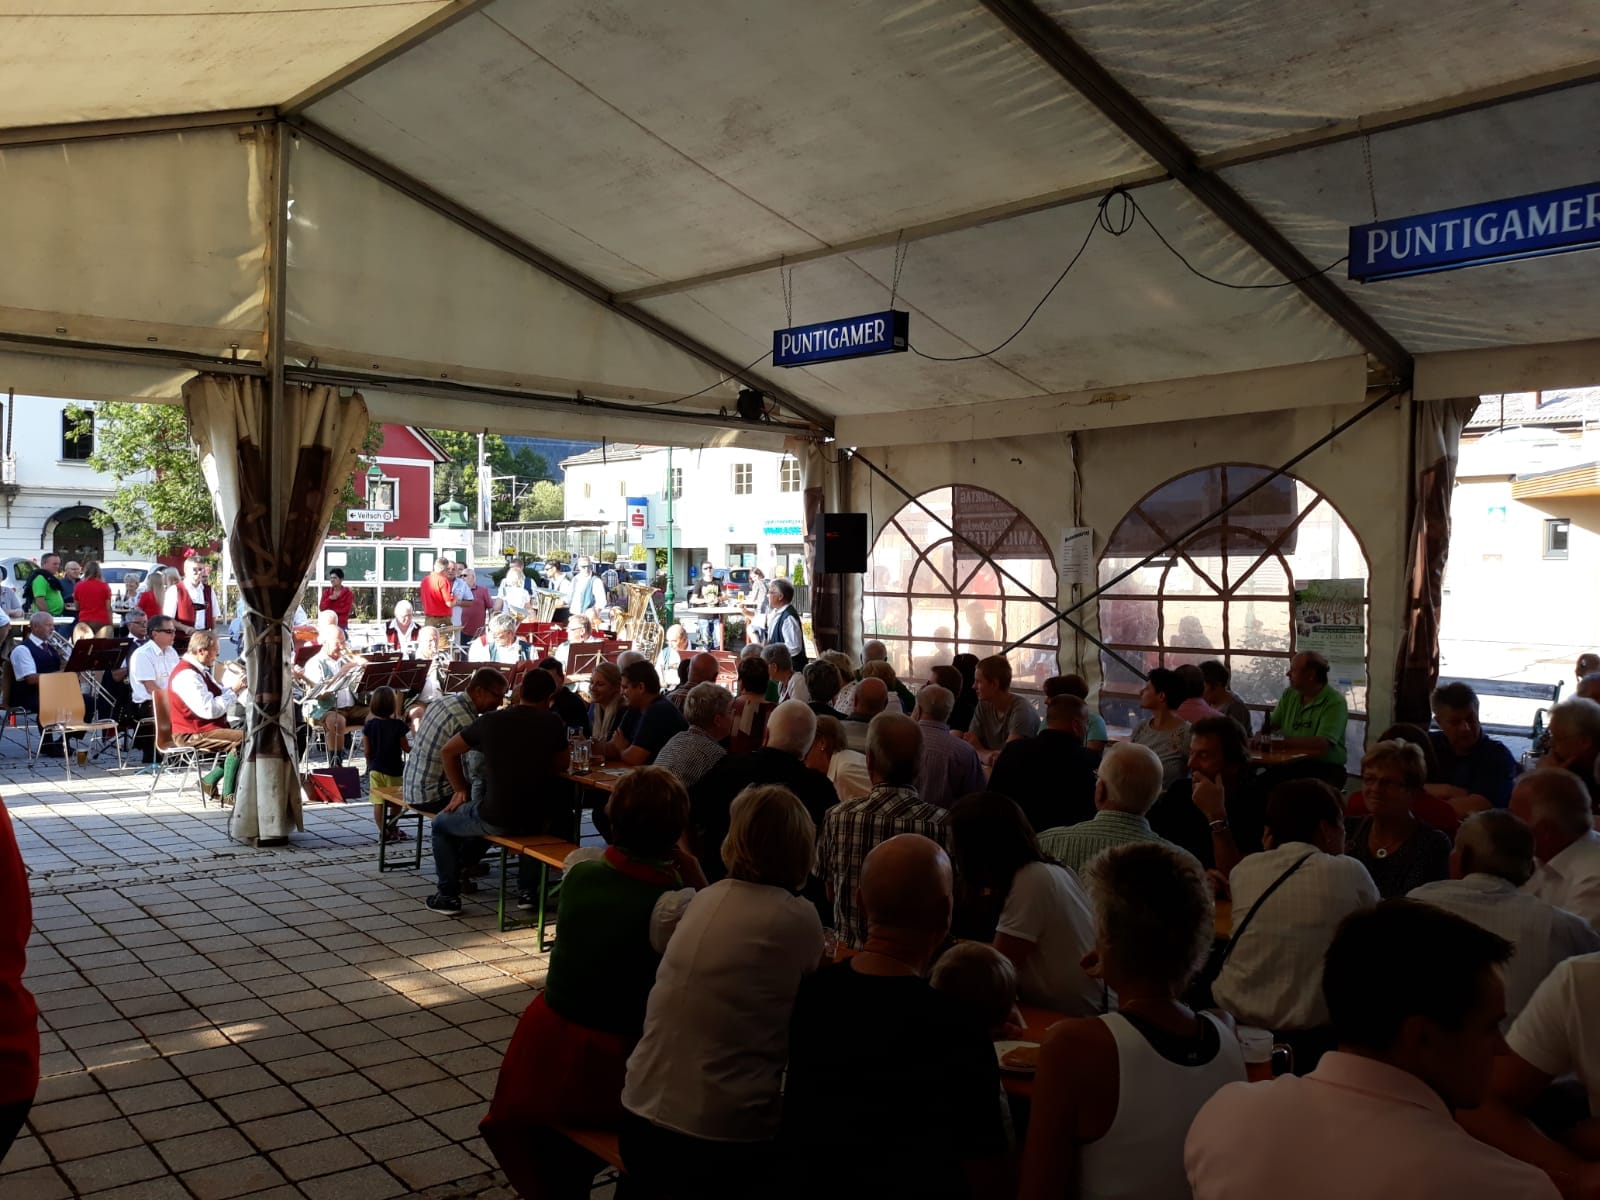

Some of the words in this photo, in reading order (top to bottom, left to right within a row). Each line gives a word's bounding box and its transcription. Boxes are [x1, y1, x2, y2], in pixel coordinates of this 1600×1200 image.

[1366, 192, 1600, 265] PUNTIGAMER
[780, 319, 886, 357] PUNTIGAMER
[357, 511, 382, 520] Veitsch
